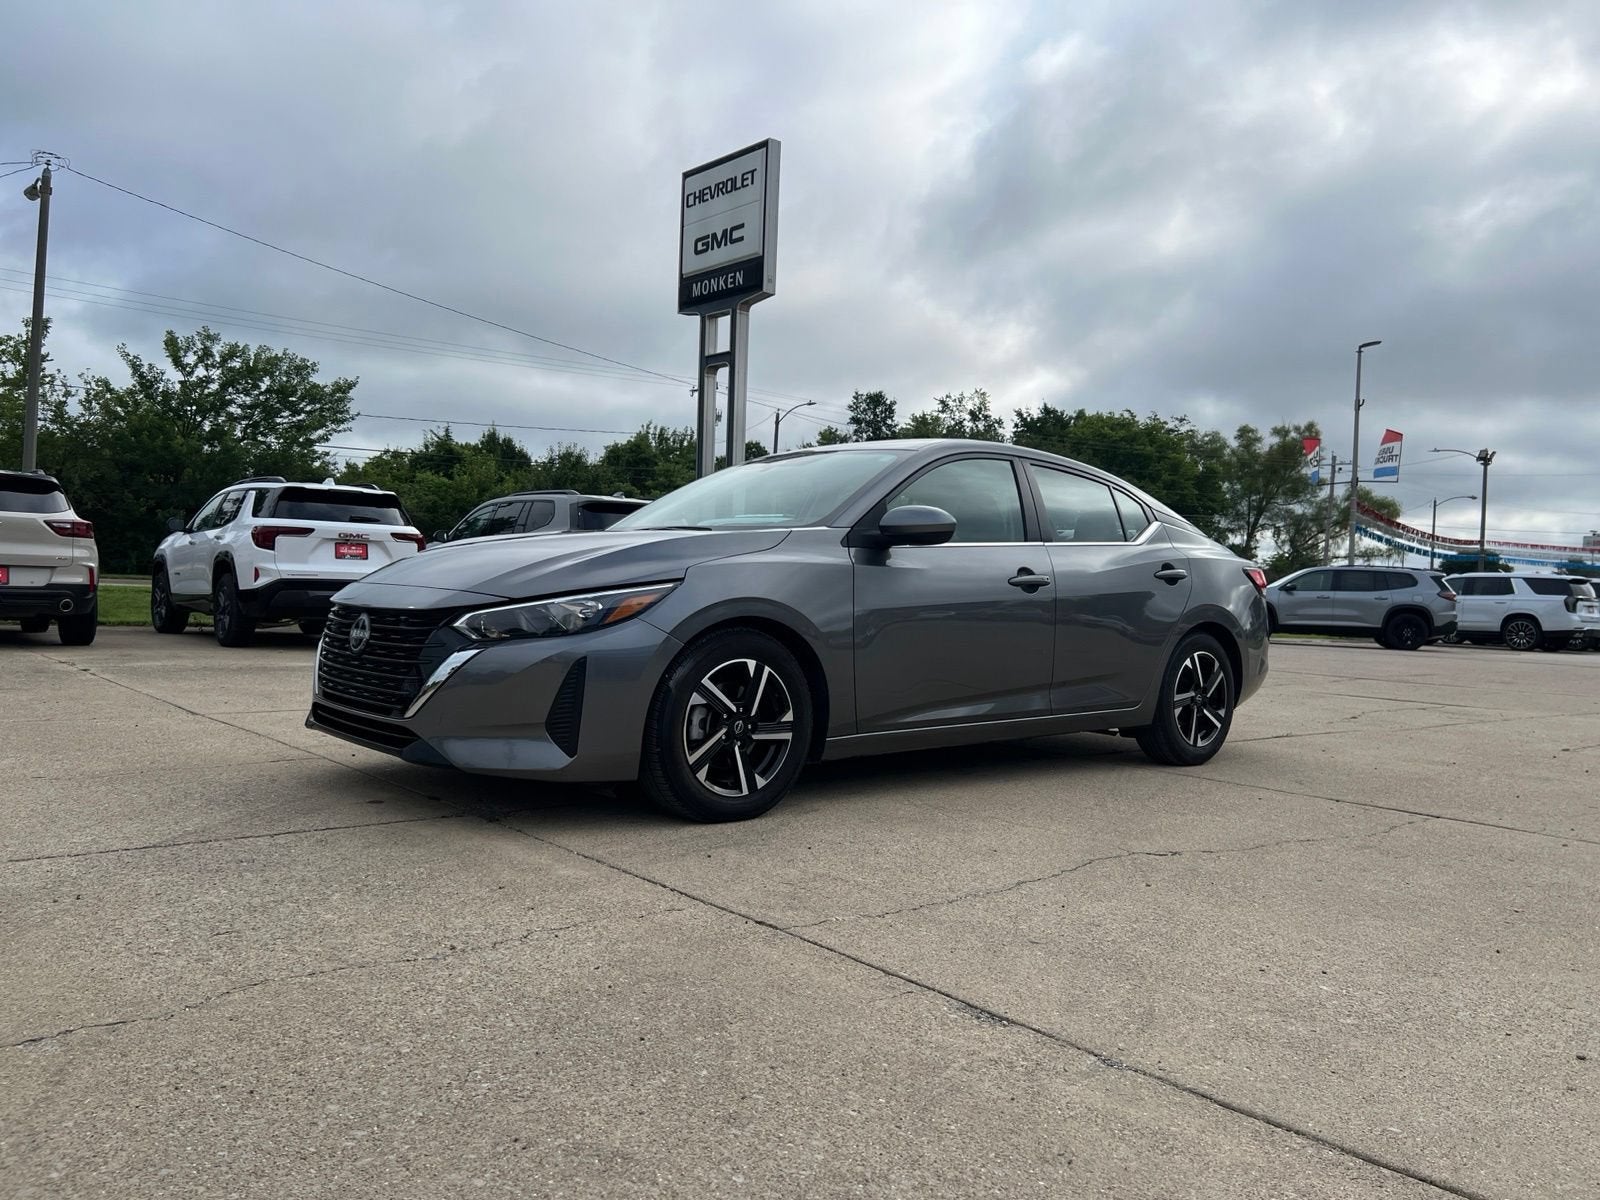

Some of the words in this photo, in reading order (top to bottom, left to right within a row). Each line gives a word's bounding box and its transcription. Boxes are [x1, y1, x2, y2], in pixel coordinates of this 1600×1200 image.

[686, 168, 757, 208] CHEVROLET
[694, 223, 745, 255] GMC
[692, 270, 744, 297] MONKEN
[338, 532, 370, 540] GMC
